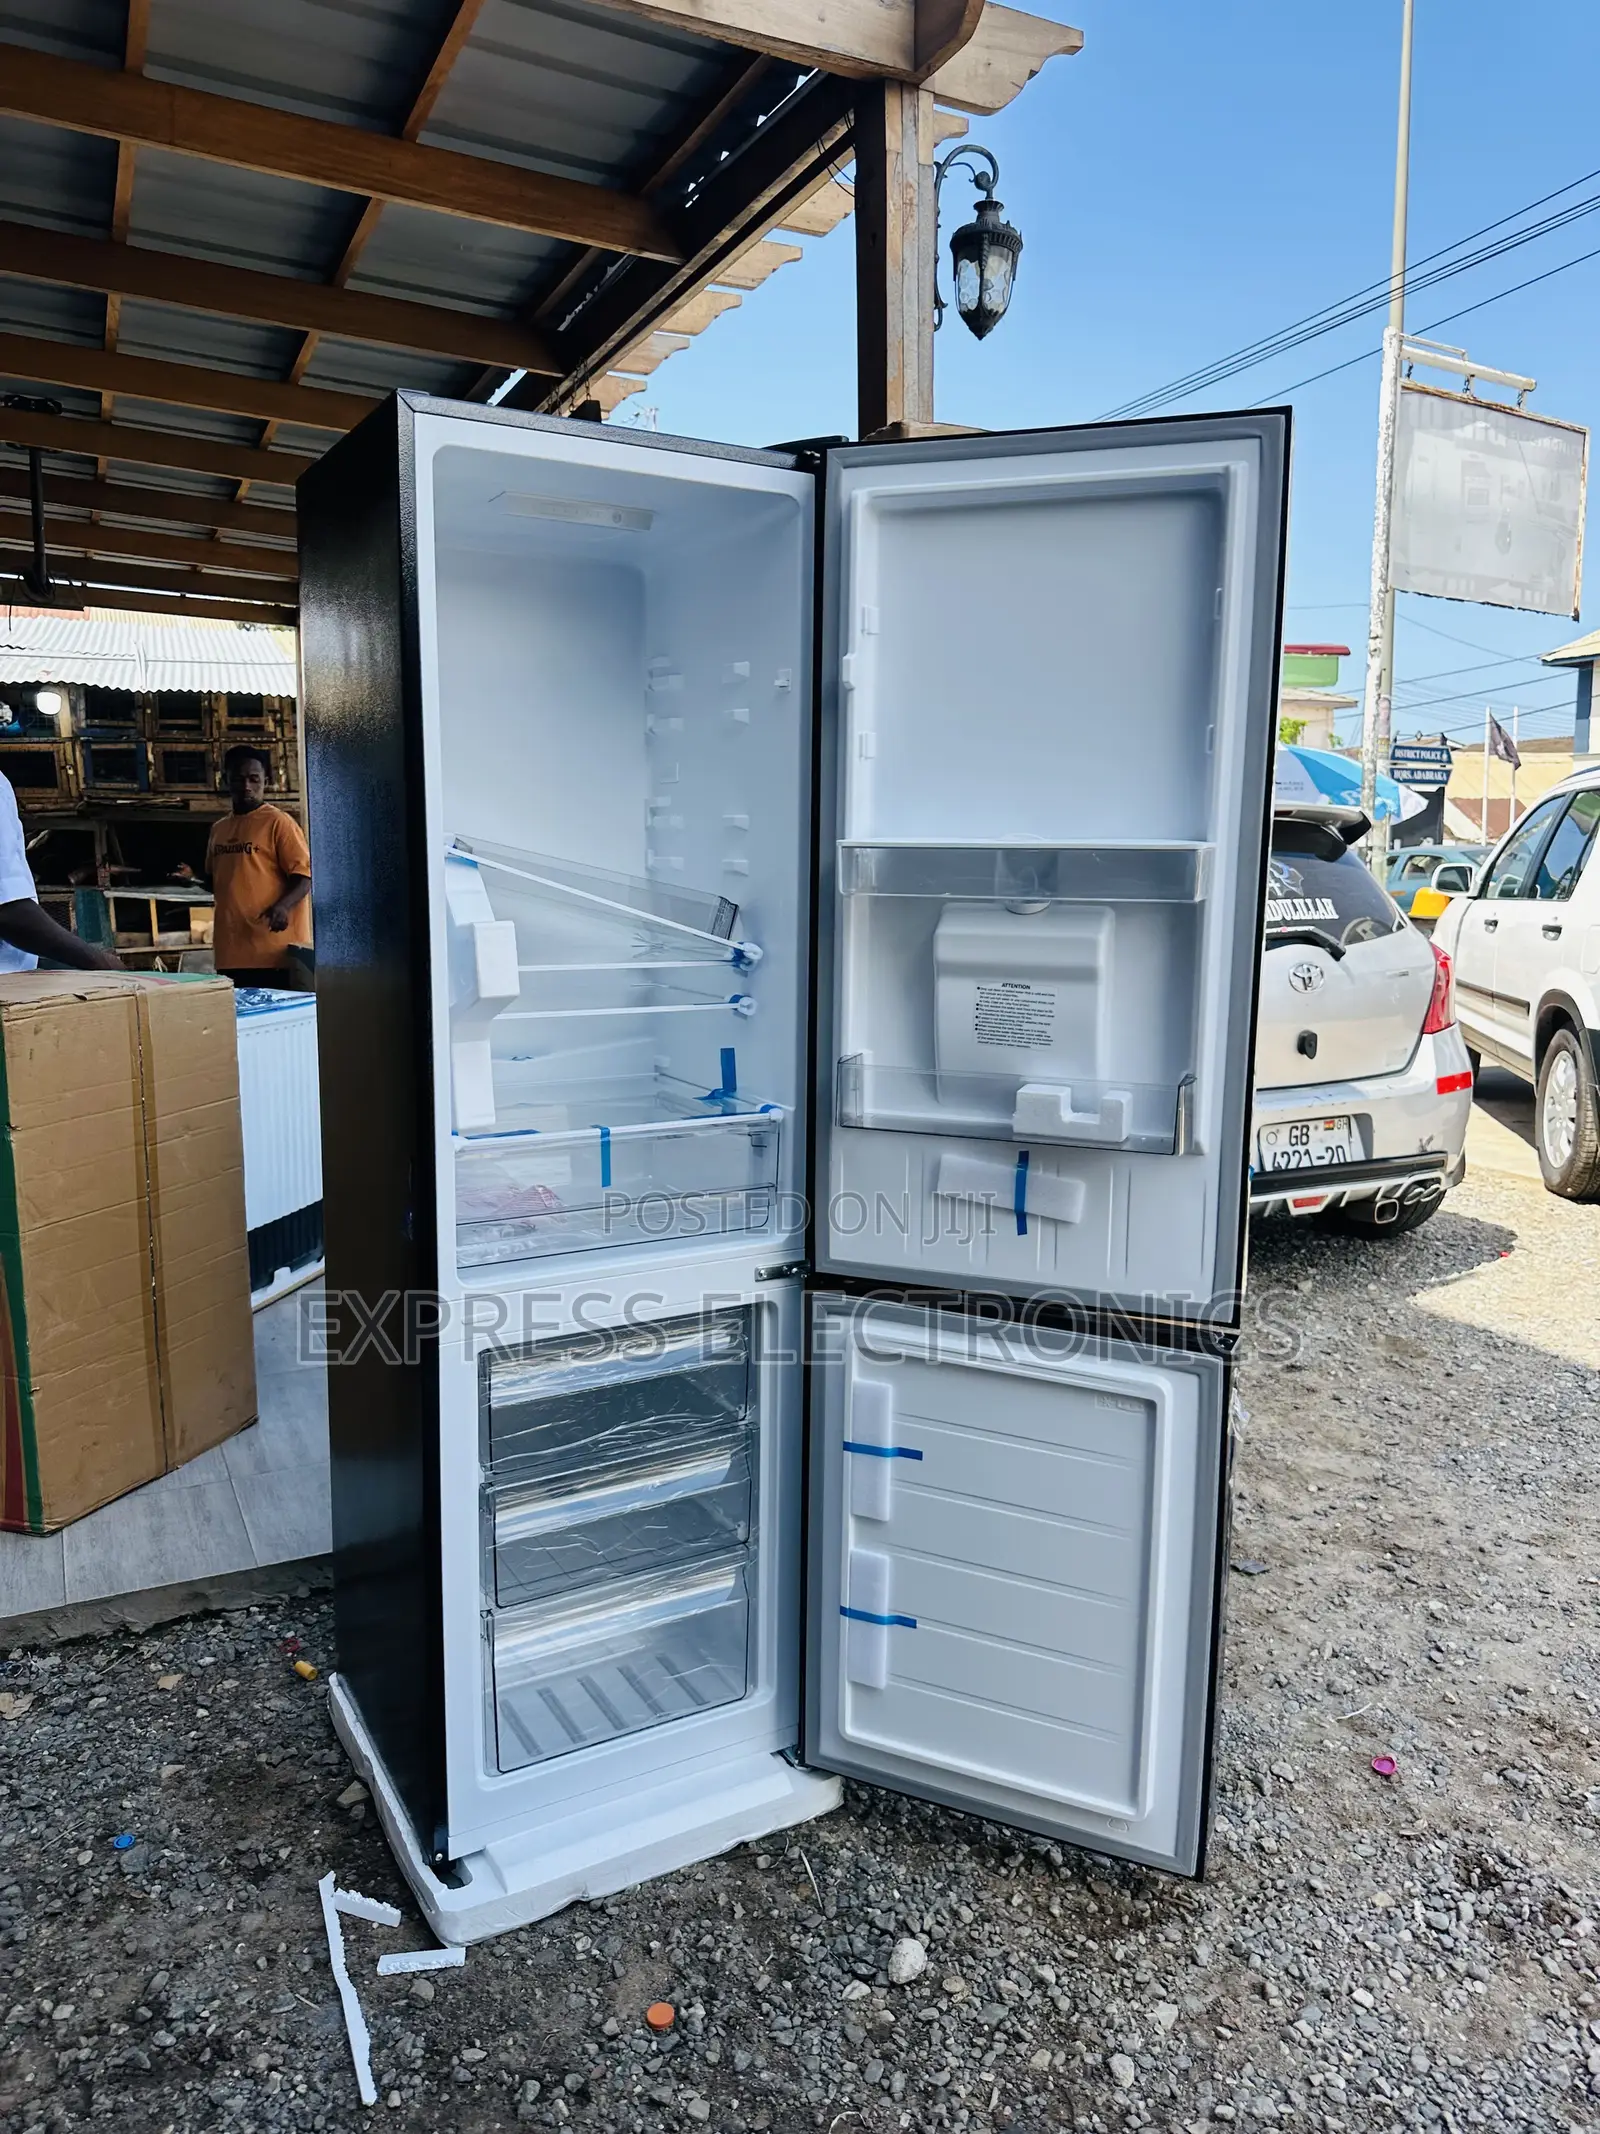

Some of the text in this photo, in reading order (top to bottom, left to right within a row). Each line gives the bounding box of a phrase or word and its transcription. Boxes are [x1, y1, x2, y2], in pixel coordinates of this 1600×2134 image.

[1395, 749, 1441, 760] DISTRICT POLICE
[1264, 898, 1339, 921] DULILLAH
[1289, 1119, 1348, 1147] GB GH
[1272, 1145, 1347, 1170] 4221-20
